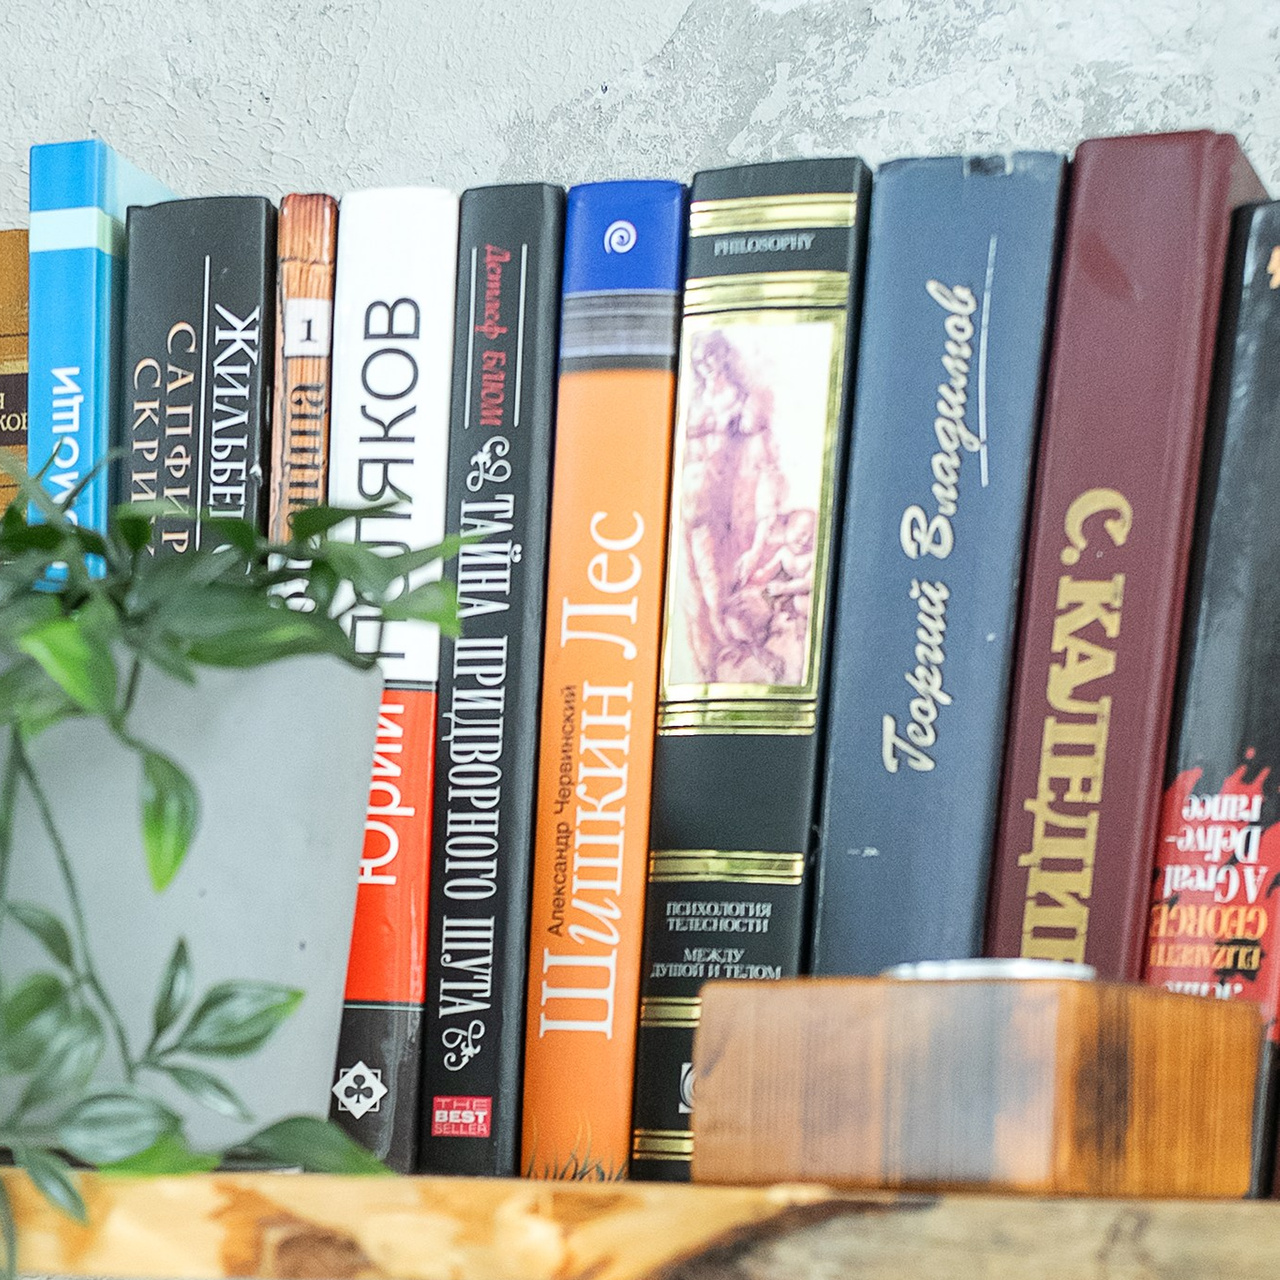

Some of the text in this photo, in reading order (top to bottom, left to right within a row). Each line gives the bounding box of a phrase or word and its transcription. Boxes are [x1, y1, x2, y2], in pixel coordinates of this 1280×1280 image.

[714, 232, 816, 257] PHILOSOPHY
[478, 350, 507, 427] БЛЮМ
[161, 320, 197, 555] САПФИР
[882, 279, 981, 773] Георгий Владимов
[438, 493, 523, 1020] ТАЙНА ПРИДВОРНОГО ШУТА
[538, 510, 645, 1040] Шишкин Лес
[548, 684, 577, 937] Александр Червинский
[1181, 793, 1264, 822] rance
[1163, 864, 1268, 903] A Great
[666, 901, 773, 918] ПСИХОЛОГИЯ
[1149, 903, 1269, 940] GEORGE
[667, 917, 770, 933] ТЕЛЕСНОСТИ
[683, 948, 745, 963] МЕЖДУ
[650, 963, 782, 979] ДУШОЙ И ТЕЛОМ
[434, 1109, 488, 1123] BEST
[436, 1097, 489, 1110] THE
[433, 1123, 488, 1136] SELLER
